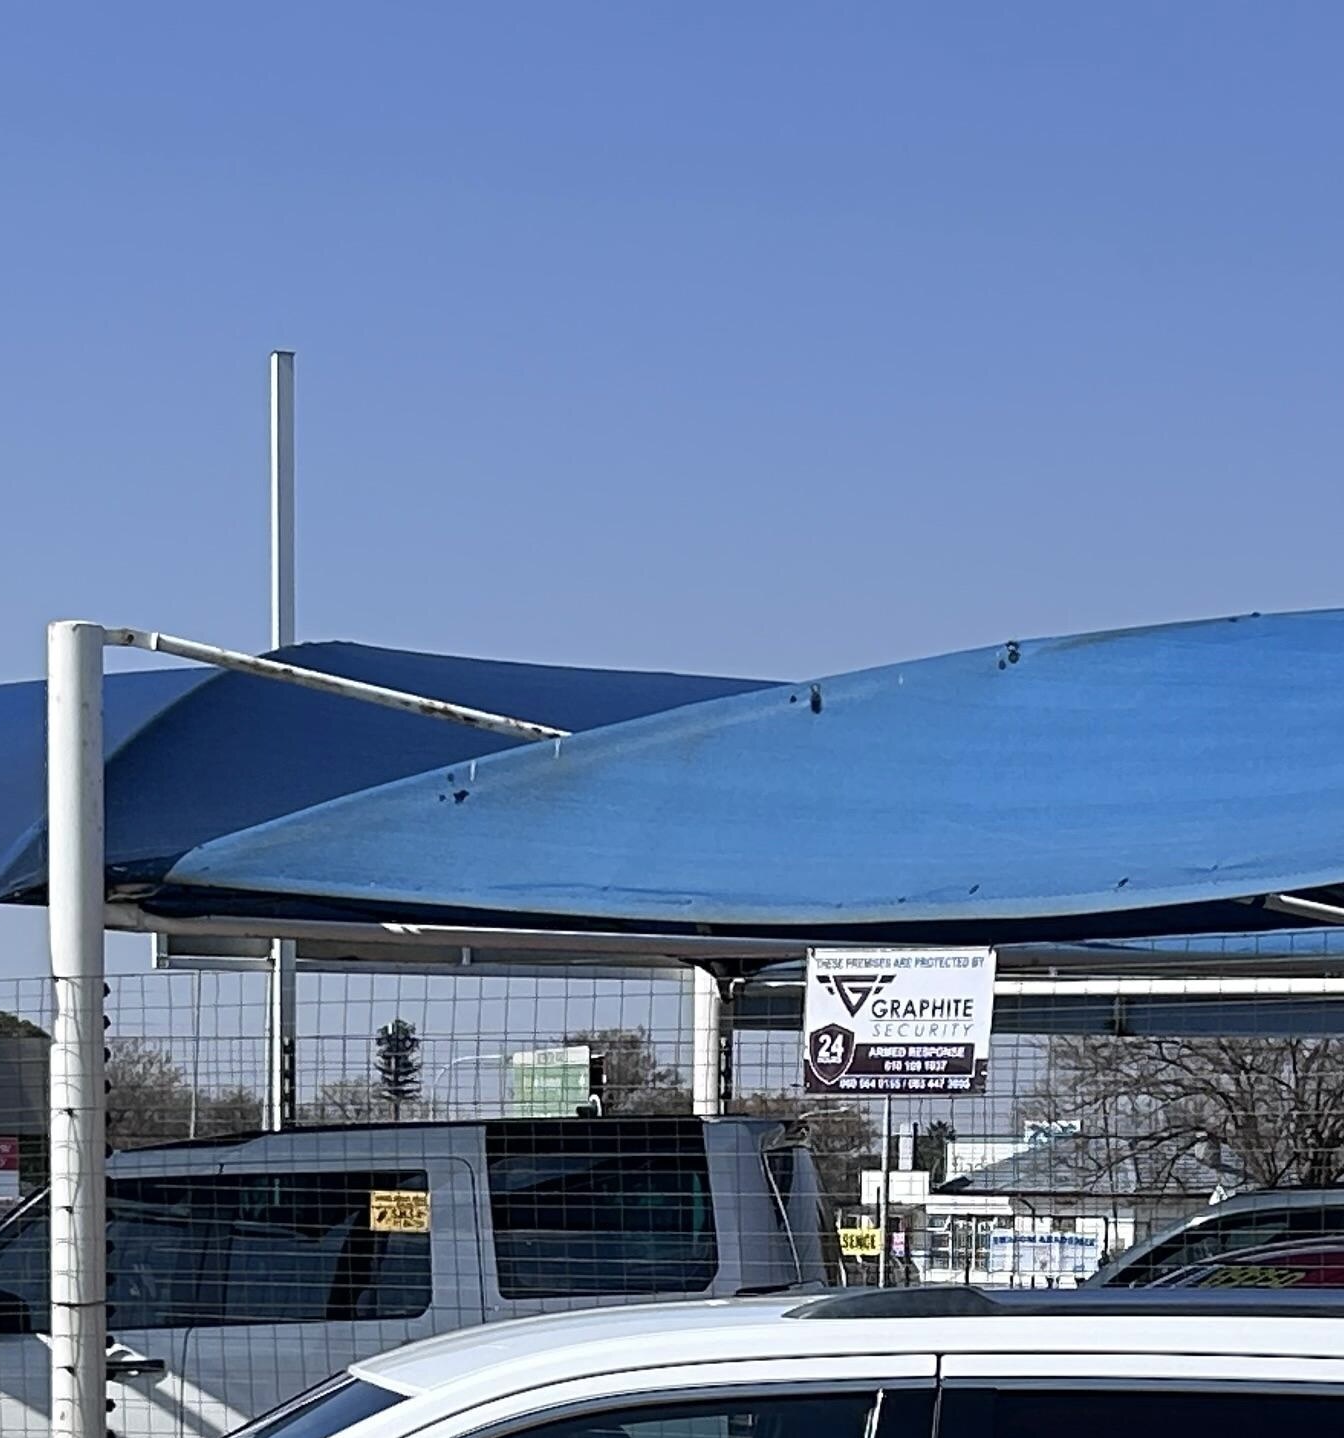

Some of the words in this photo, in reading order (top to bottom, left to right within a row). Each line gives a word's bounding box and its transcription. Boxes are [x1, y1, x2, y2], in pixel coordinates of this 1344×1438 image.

[871, 998, 974, 1019] GRAPHITE
[871, 1023, 974, 1038] SECURITY
[818, 1033, 844, 1058] 24
